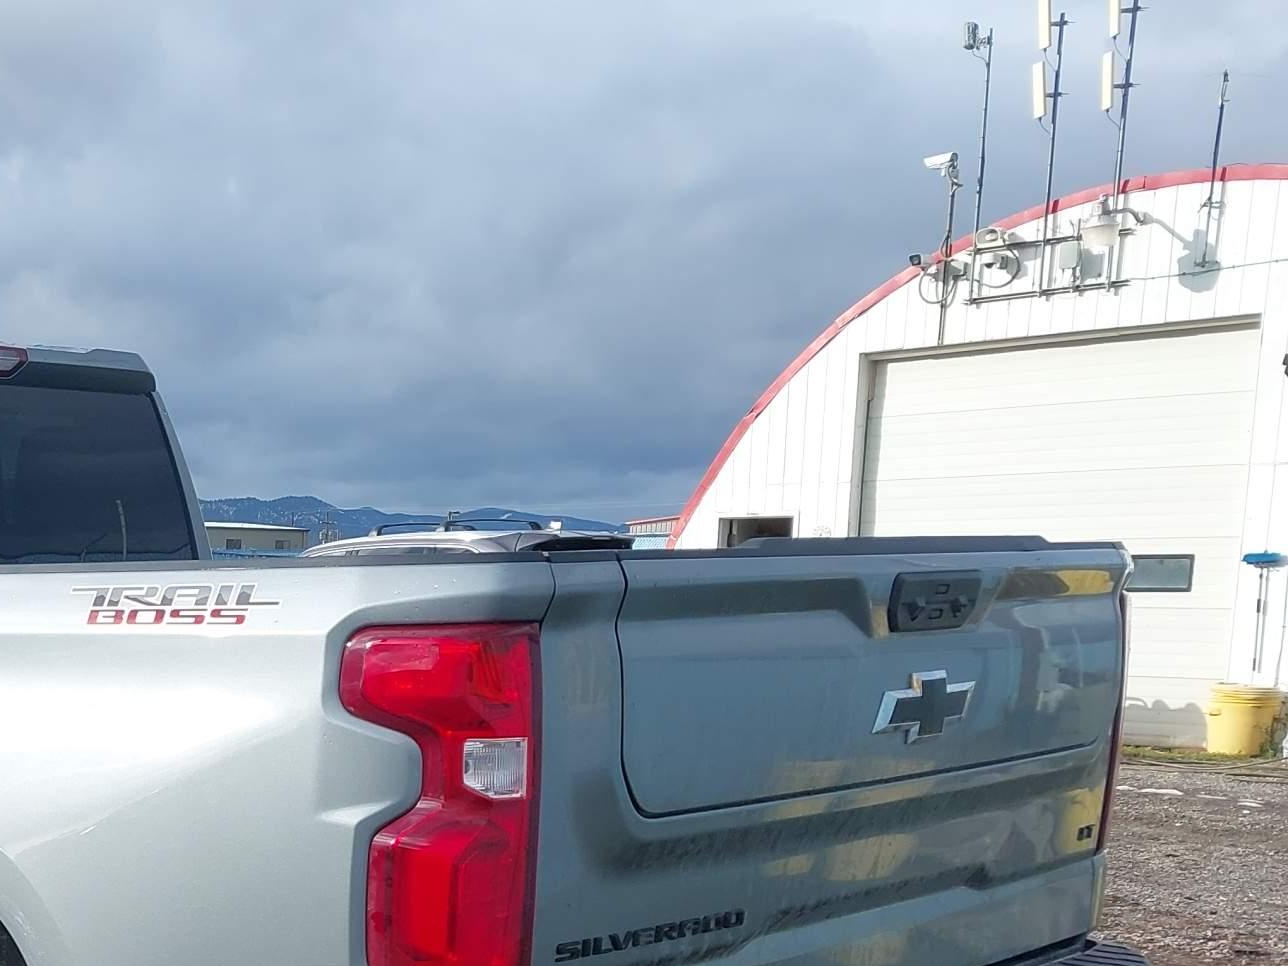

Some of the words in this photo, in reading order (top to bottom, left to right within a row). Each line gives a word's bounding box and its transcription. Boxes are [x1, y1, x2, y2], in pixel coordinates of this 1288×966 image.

[71, 583, 280, 606] TRAIL
[87, 608, 249, 625] BOSS
[554, 908, 746, 963] SILVERADO
